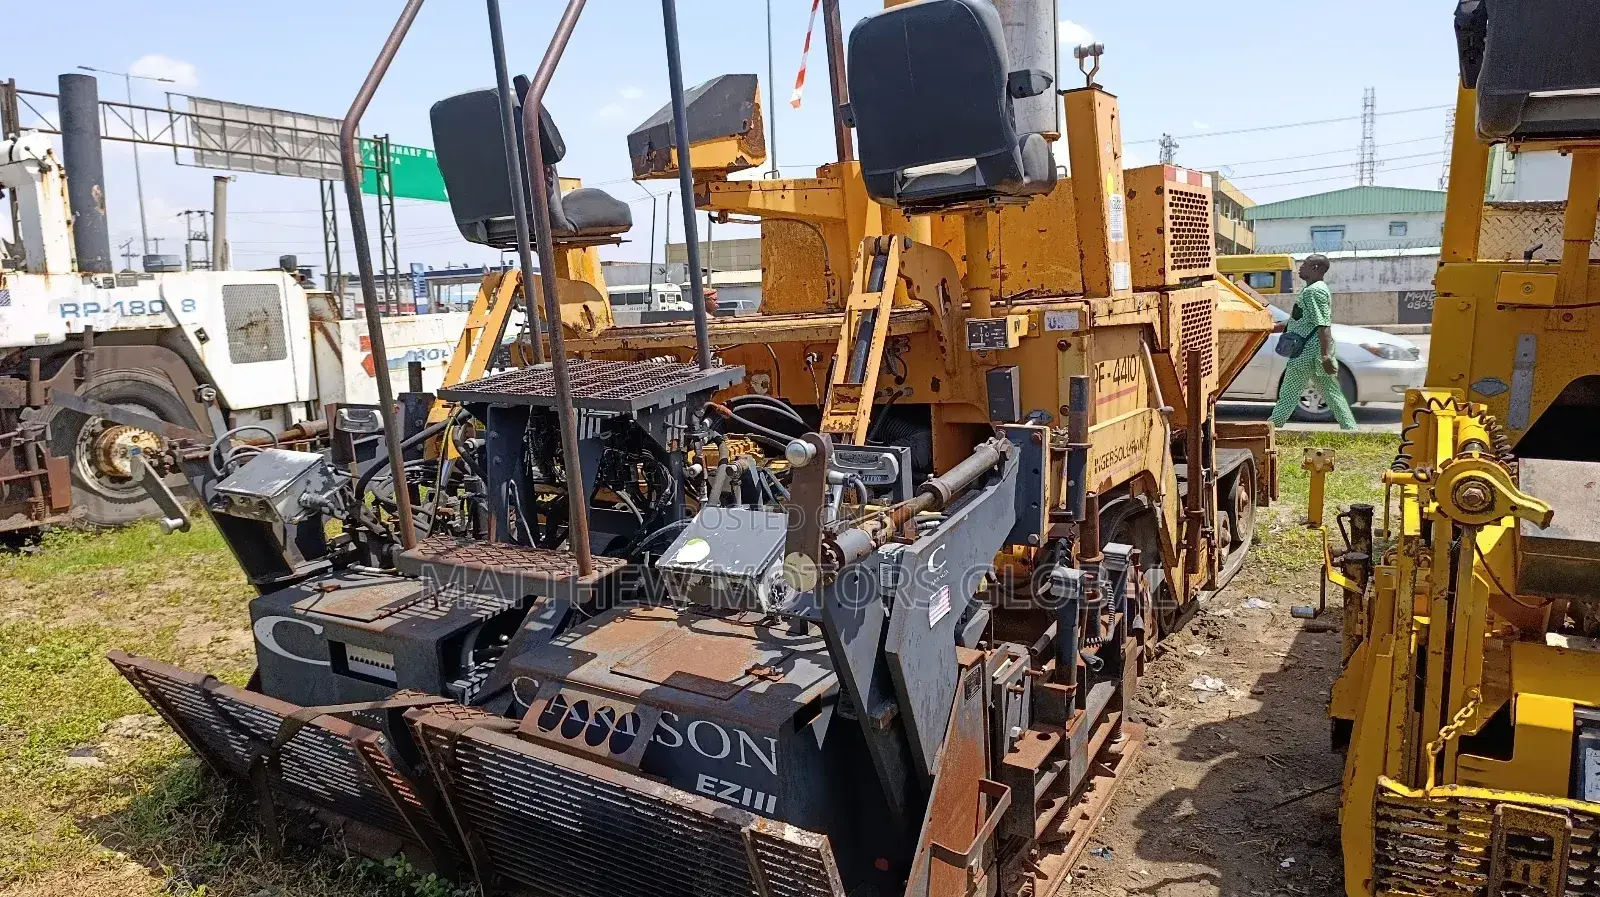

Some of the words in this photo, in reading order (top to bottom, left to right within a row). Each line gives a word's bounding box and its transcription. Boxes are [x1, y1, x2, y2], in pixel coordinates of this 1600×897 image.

[60, 299, 165, 319] RP-180
[181, 298, 196, 313] 8
[695, 773, 778, 814] EZIII
